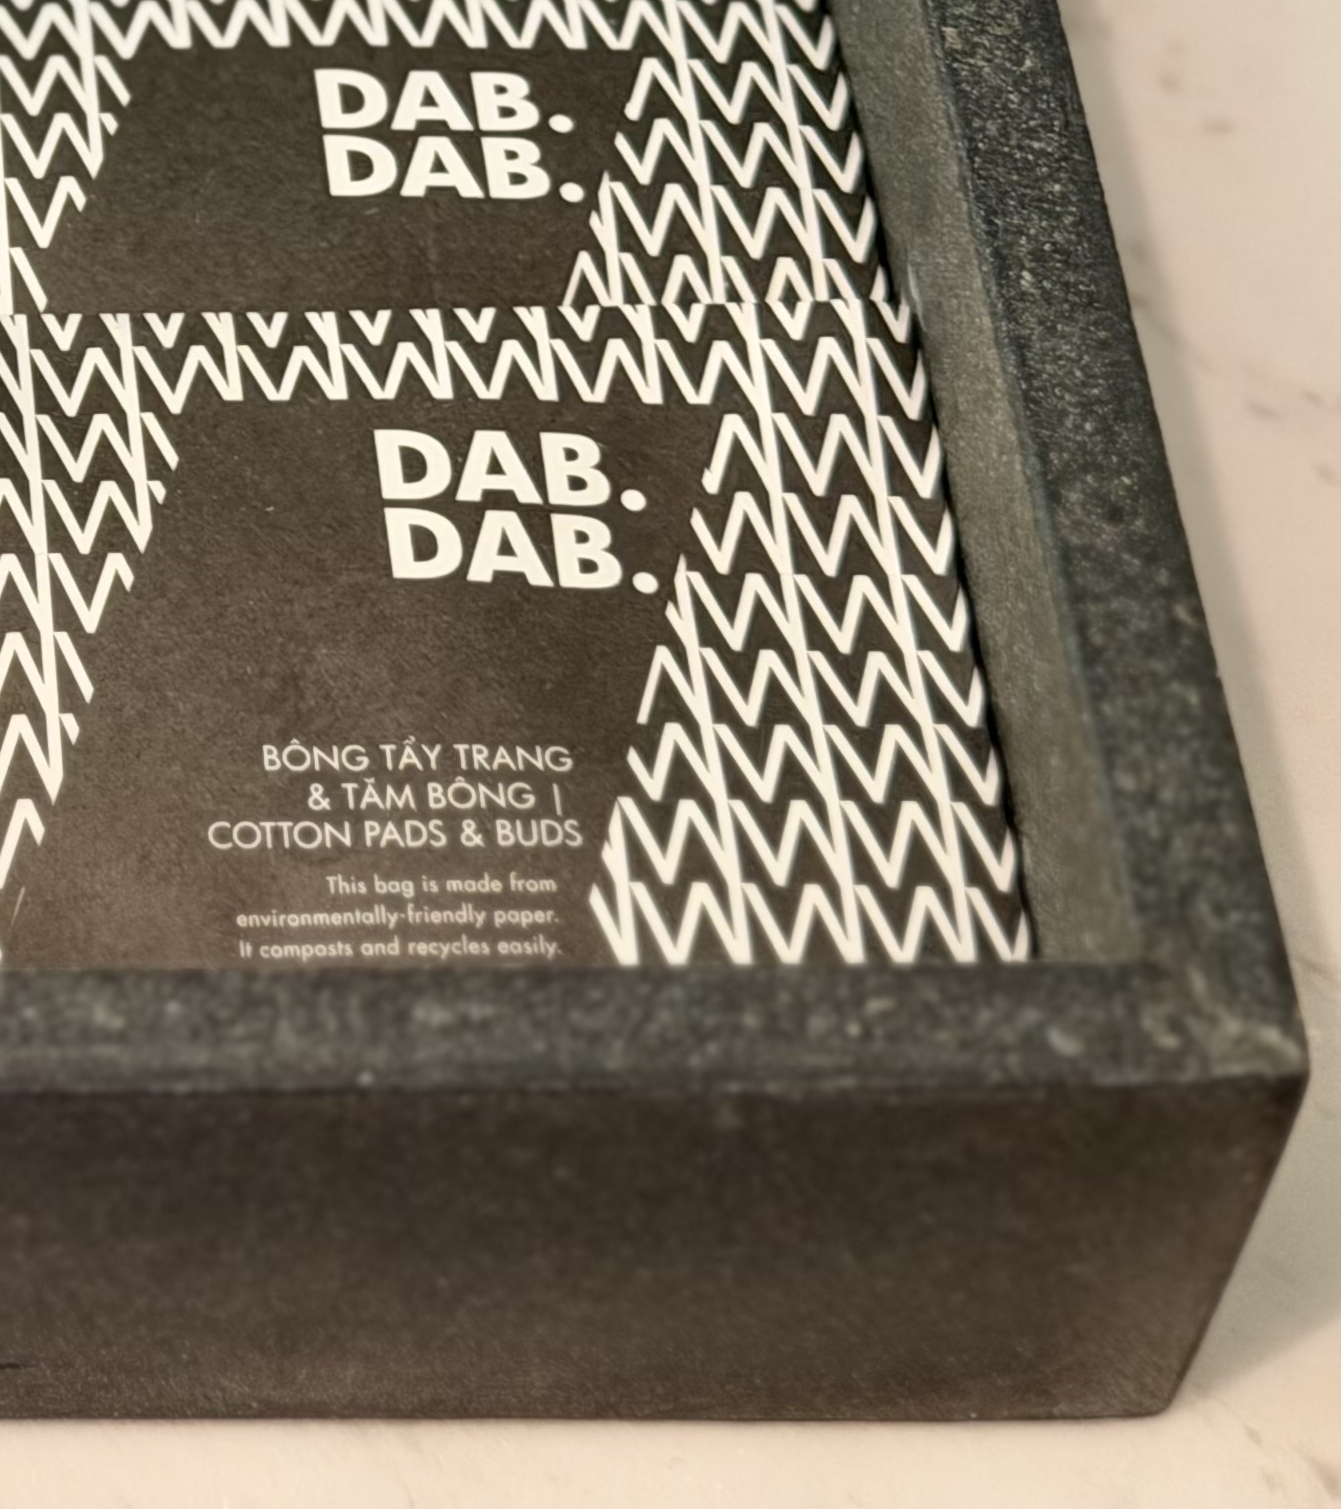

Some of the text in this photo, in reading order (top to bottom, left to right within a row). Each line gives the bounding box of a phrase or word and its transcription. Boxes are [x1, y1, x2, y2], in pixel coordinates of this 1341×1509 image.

[314, 68, 574, 134] DAB.
[323, 134, 585, 203] DAB.
[373, 428, 647, 512] DAB.
[383, 506, 659, 595] DAB.
[262, 735, 573, 772] BÔNG TẨY TRANG
[307, 783, 332, 811] &
[340, 777, 416, 810] TĂM
[427, 775, 536, 810] BÔNG
[207, 818, 583, 850] COTTON PADS & BUDS
[325, 871, 558, 899] This bag is made from
[236, 902, 560, 930] environmentally-friendly paper.
[239, 934, 563, 962] It composts and recycles easily.
